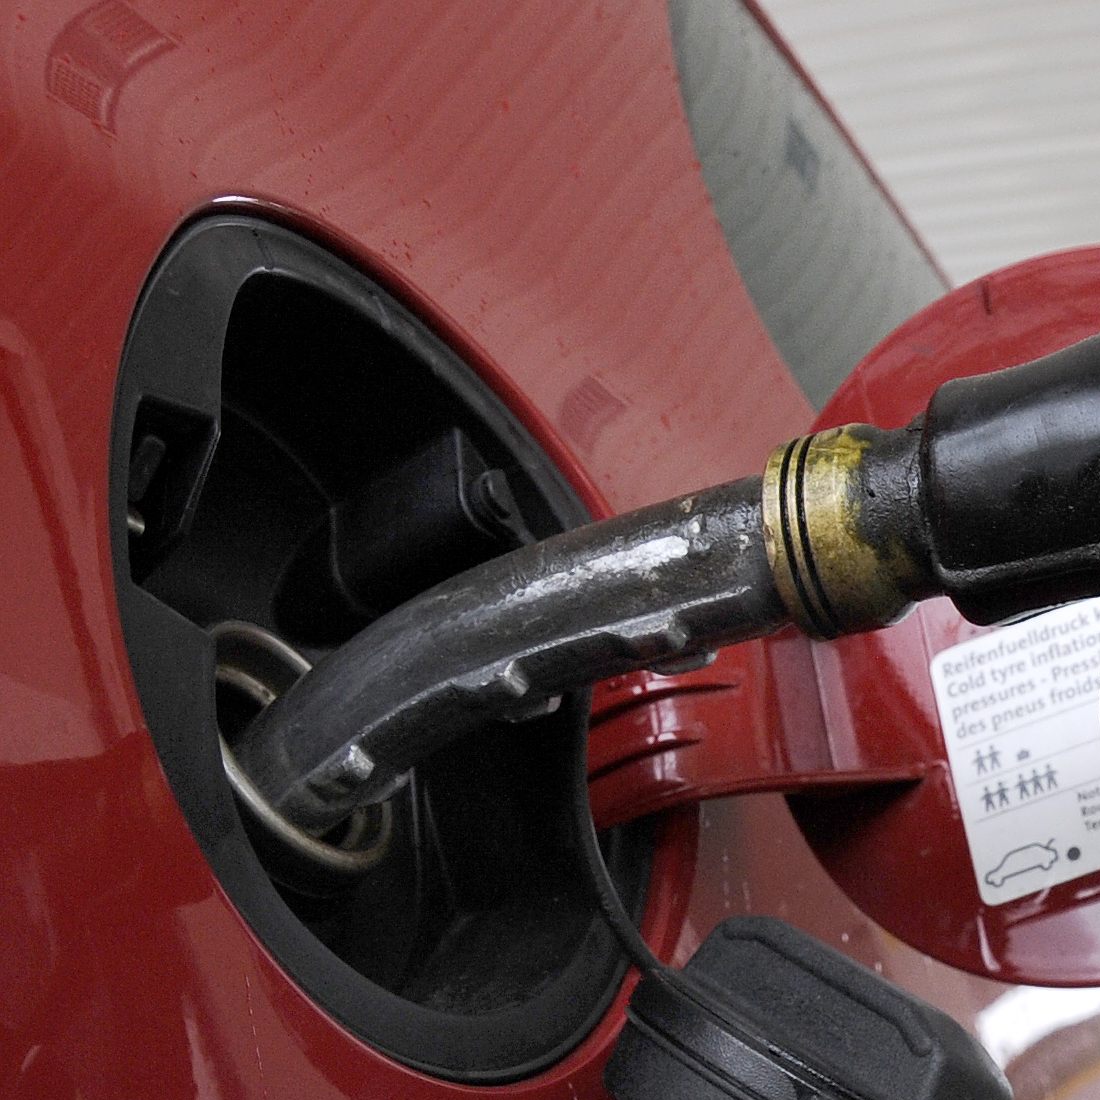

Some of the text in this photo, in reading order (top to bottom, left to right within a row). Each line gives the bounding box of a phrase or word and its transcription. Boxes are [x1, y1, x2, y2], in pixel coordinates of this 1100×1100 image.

[942, 613, 1090, 678] Reifenfuelldruck
[946, 672, 987, 698] Cold
[990, 659, 1027, 685] tyre
[951, 678, 1036, 723] pressures
[956, 718, 987, 740] des
[991, 699, 1047, 732] pneus
